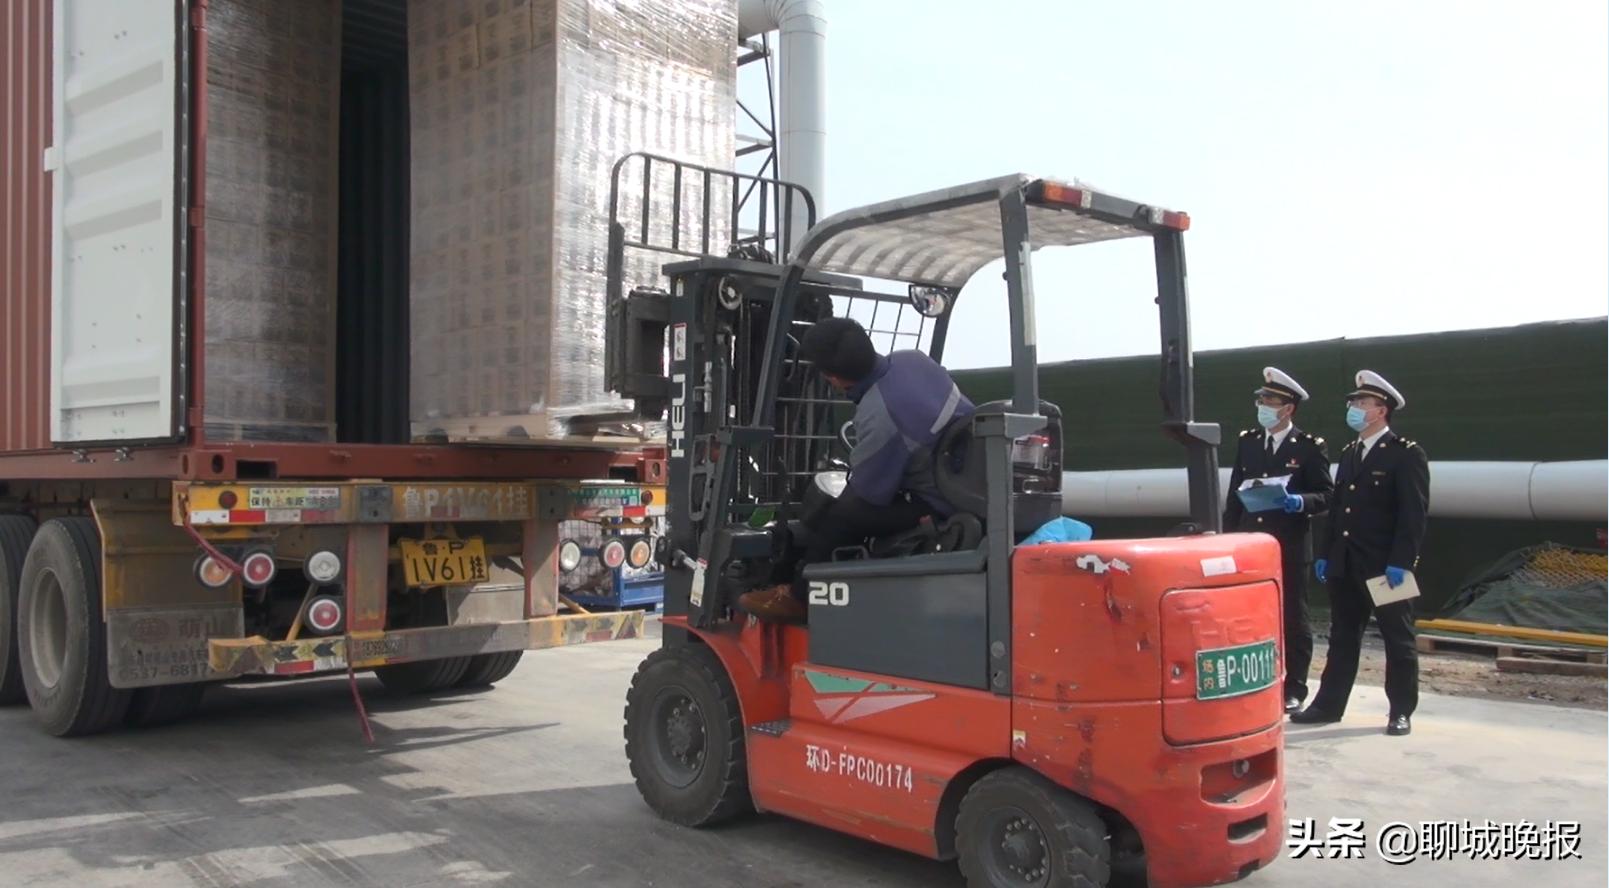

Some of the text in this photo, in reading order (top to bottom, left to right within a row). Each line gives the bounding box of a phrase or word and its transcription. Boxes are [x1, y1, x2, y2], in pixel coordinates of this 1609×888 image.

[671, 373, 686, 458] HELI
[412, 555, 485, 582] 1V61挂
[809, 581, 850, 607] 20
[805, 743, 914, 793] 环D-FPC00174
